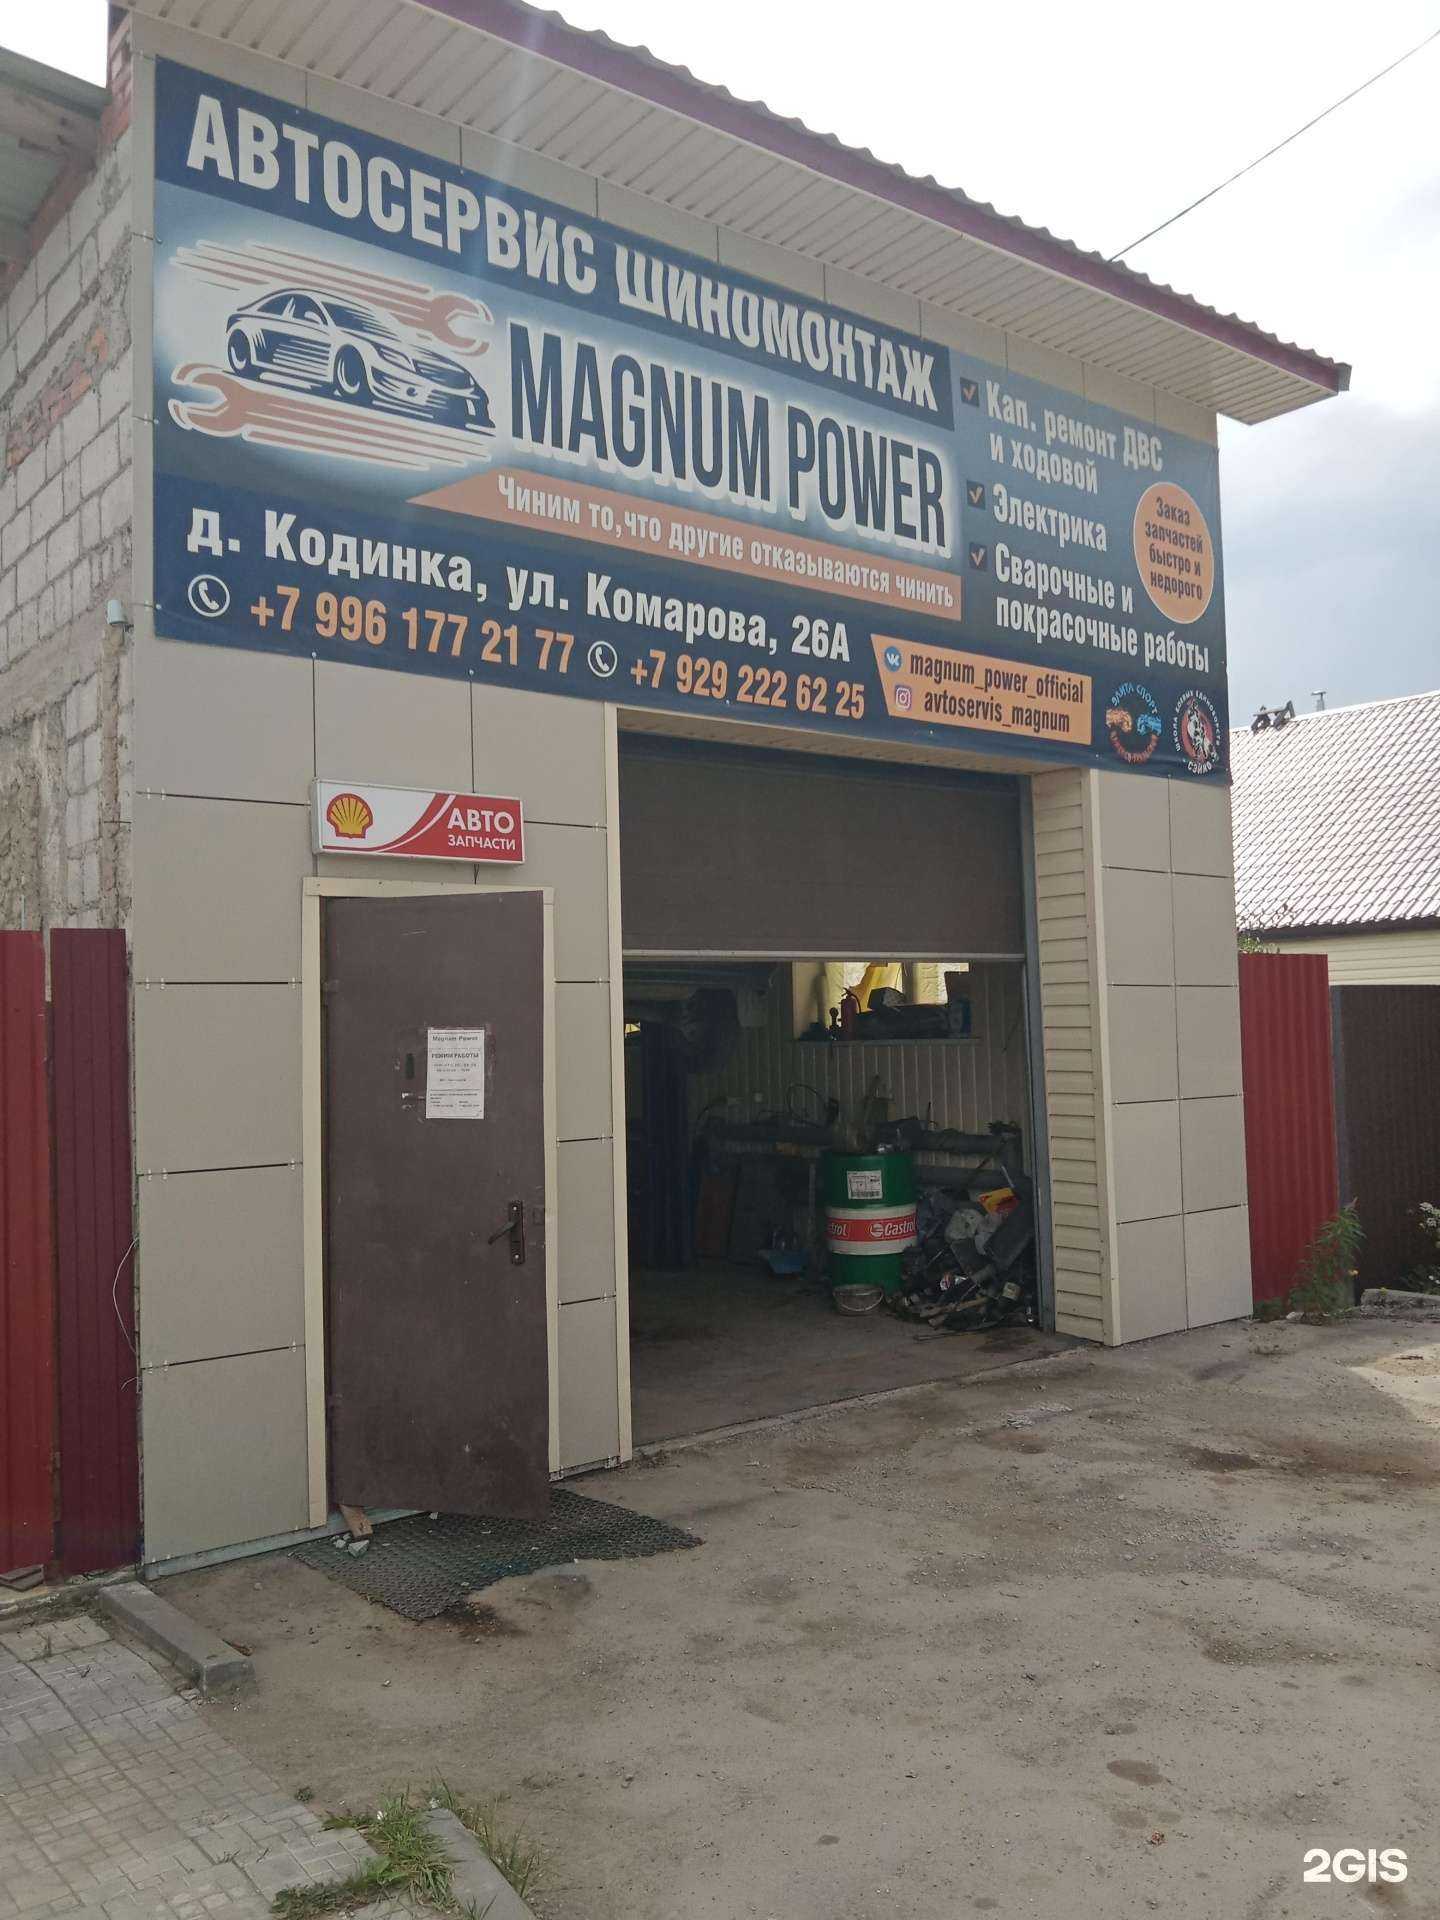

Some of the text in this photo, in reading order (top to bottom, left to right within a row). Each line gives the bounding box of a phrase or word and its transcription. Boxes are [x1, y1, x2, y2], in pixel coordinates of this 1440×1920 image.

[187, 94, 939, 412] АВТОСЕРВИС ШИНОМОНТАЖ
[509, 321, 947, 549] MAGNUM POWER
[986, 380, 1163, 472] Кап. ремонт ДВС
[1011, 440, 1098, 495] ходовой
[498, 474, 581, 524] Чиним
[668, 522, 744, 560] другие
[750, 539, 890, 595] отказываются
[895, 577, 954, 609] чинить
[993, 483, 1107, 552] Электрика
[1145, 521, 1203, 554] запчастей
[1156, 496, 1191, 527] Заказ
[264, 509, 488, 602] Кодинка,
[506, 565, 569, 611] ул.
[587, 572, 778, 656] Комарова,
[791, 614, 850, 663] 26А
[995, 542, 1134, 614] Сварочные и
[1149, 543, 1201, 577] быстро и
[1150, 570, 1203, 600] недорого
[251, 585, 575, 674] +7 996 177 21 77
[996, 596, 1209, 673] покрасочные работы
[630, 649, 865, 720] +7 929 222 62 25
[910, 653, 1084, 704] magnum_power_official
[924, 689, 1070, 734] avtoservis_magnum
[447, 807, 515, 834] АВТО
[448, 834, 516, 851] ЗАПЧАСТИ
[884, 1217, 917, 1236] Castrol
